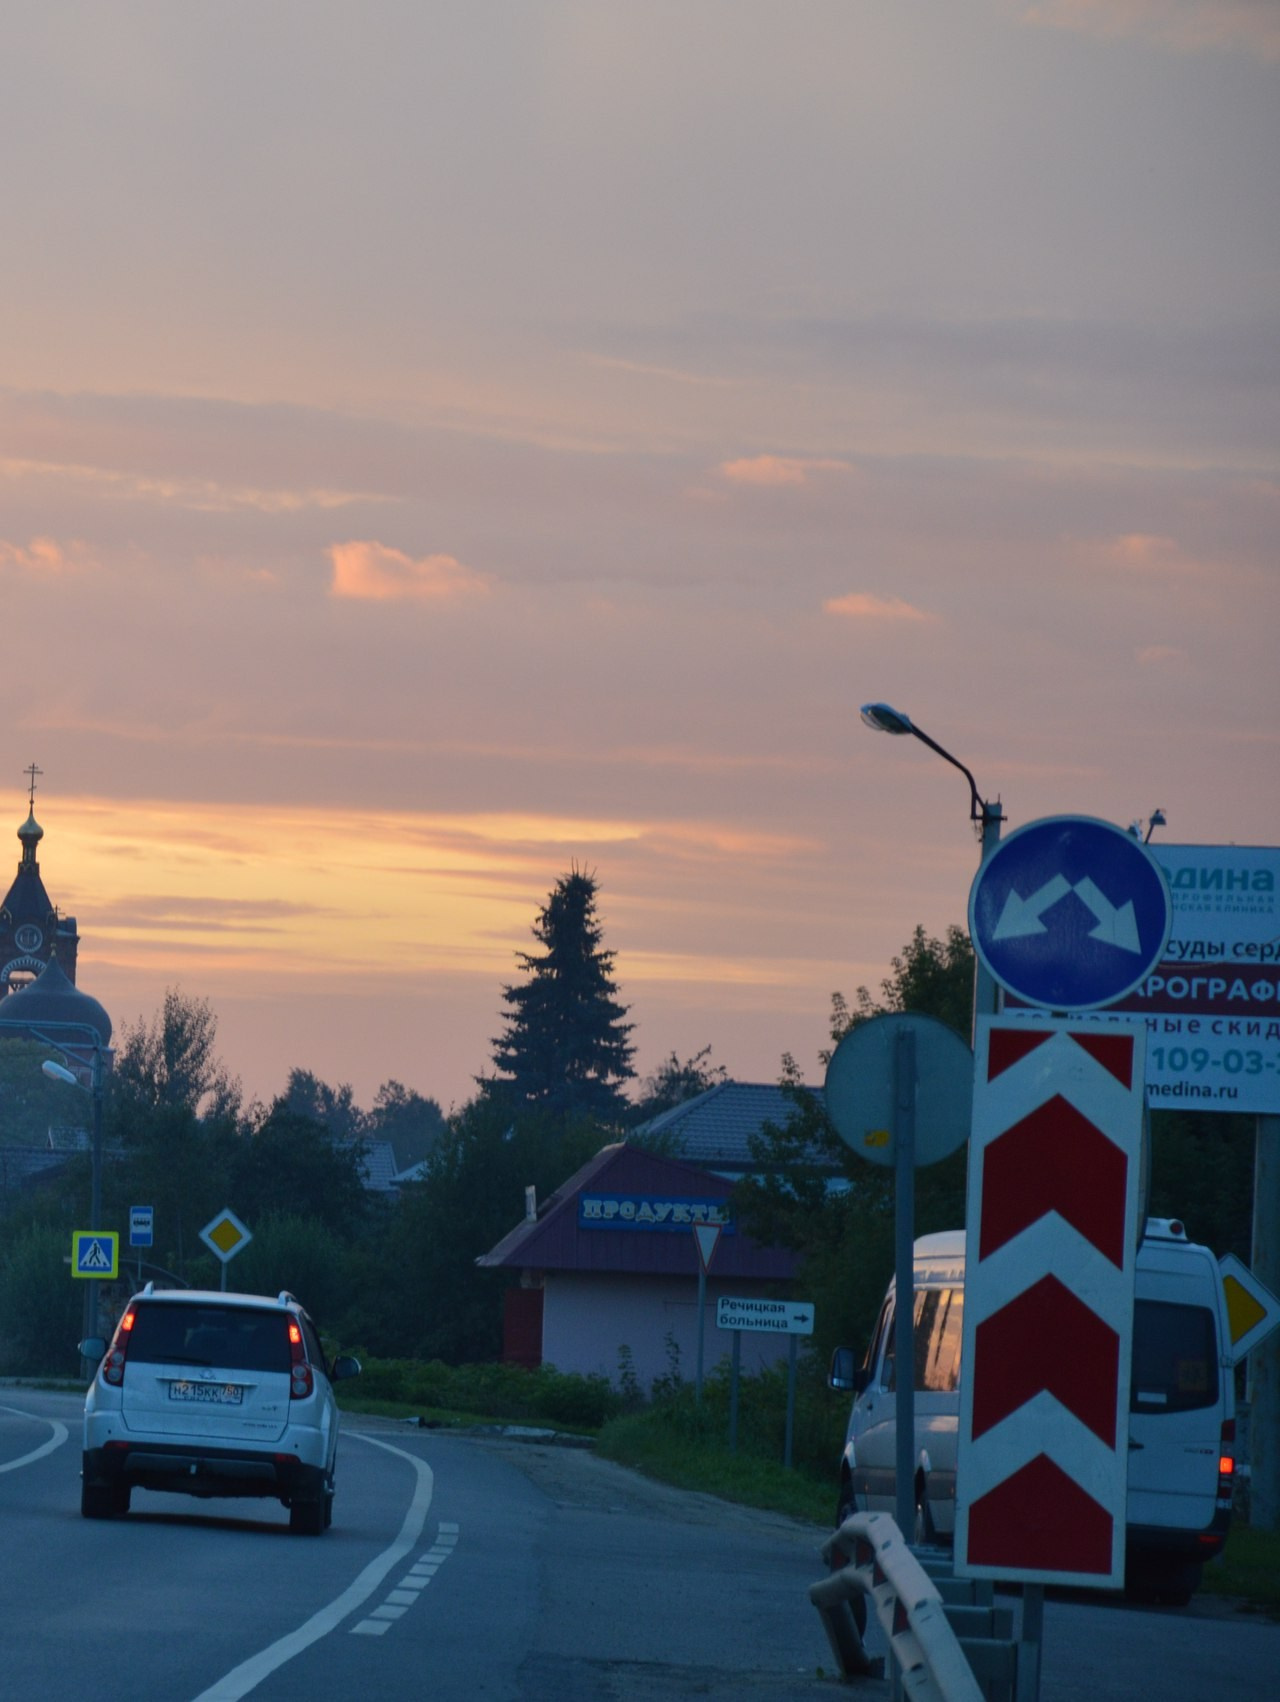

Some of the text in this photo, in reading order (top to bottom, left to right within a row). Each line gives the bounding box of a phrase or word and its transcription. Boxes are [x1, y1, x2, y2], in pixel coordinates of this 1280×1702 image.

[1137, 976, 1280, 1002] РОГРАФ
[1152, 1047, 1280, 1075] 109-03-
[583, 1199, 730, 1224] ПРОДУКТЫ
[721, 1299, 786, 1313] Речицкая
[720, 1314, 789, 1329] больница
